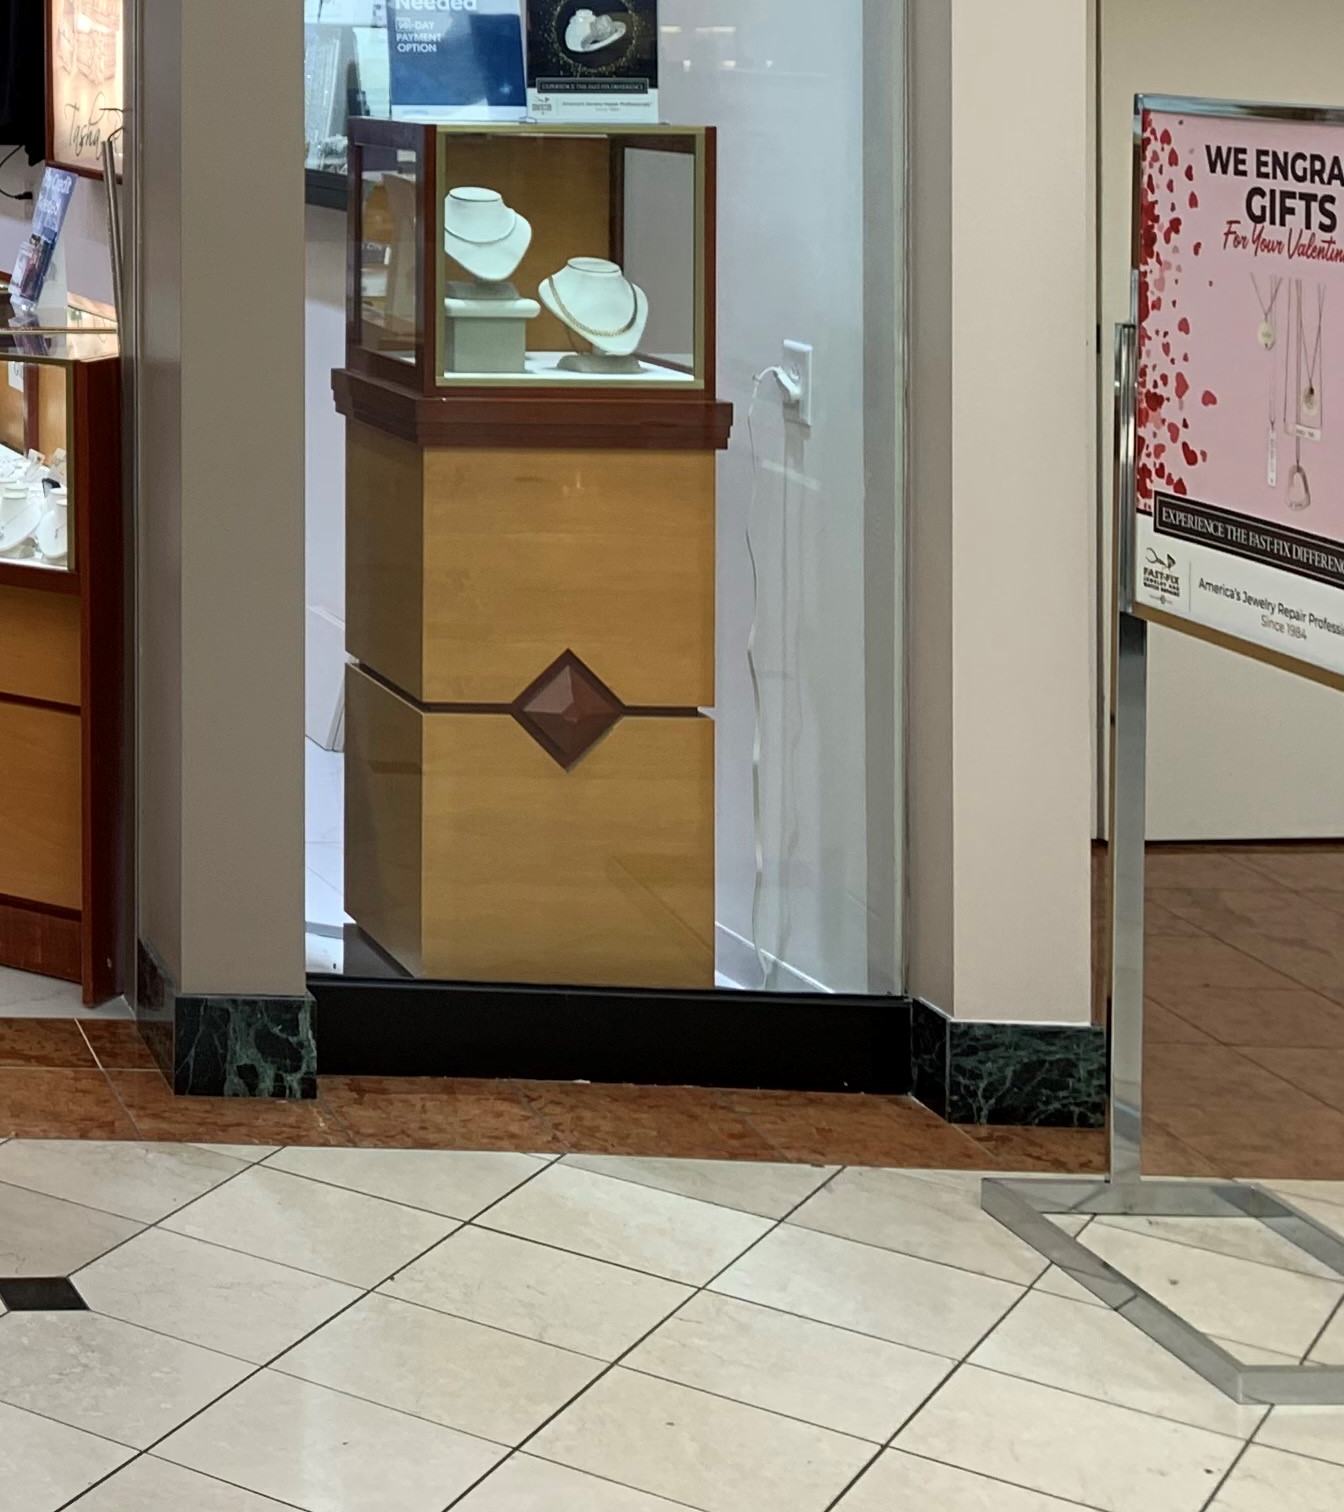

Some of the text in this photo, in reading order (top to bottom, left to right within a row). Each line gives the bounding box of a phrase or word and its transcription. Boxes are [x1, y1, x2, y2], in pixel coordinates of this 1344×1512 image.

[396, 32, 441, 42] PAYMENT
[397, 43, 437, 53] OPTION
[1205, 144, 1248, 178] WE
[1245, 187, 1338, 233] GIFTS
[1222, 220, 1248, 251] For
[1252, 224, 1285, 256] Your
[1162, 506, 1224, 536] EXPERIENCE
[1226, 527, 1248, 542] THE
[1249, 531, 1291, 558] FAST-FIX
[1199, 578, 1241, 602] America's
[1242, 589, 1276, 614] Jewelry
[1278, 602, 1307, 624] Repair
[1261, 615, 1307, 640] Since 1984
